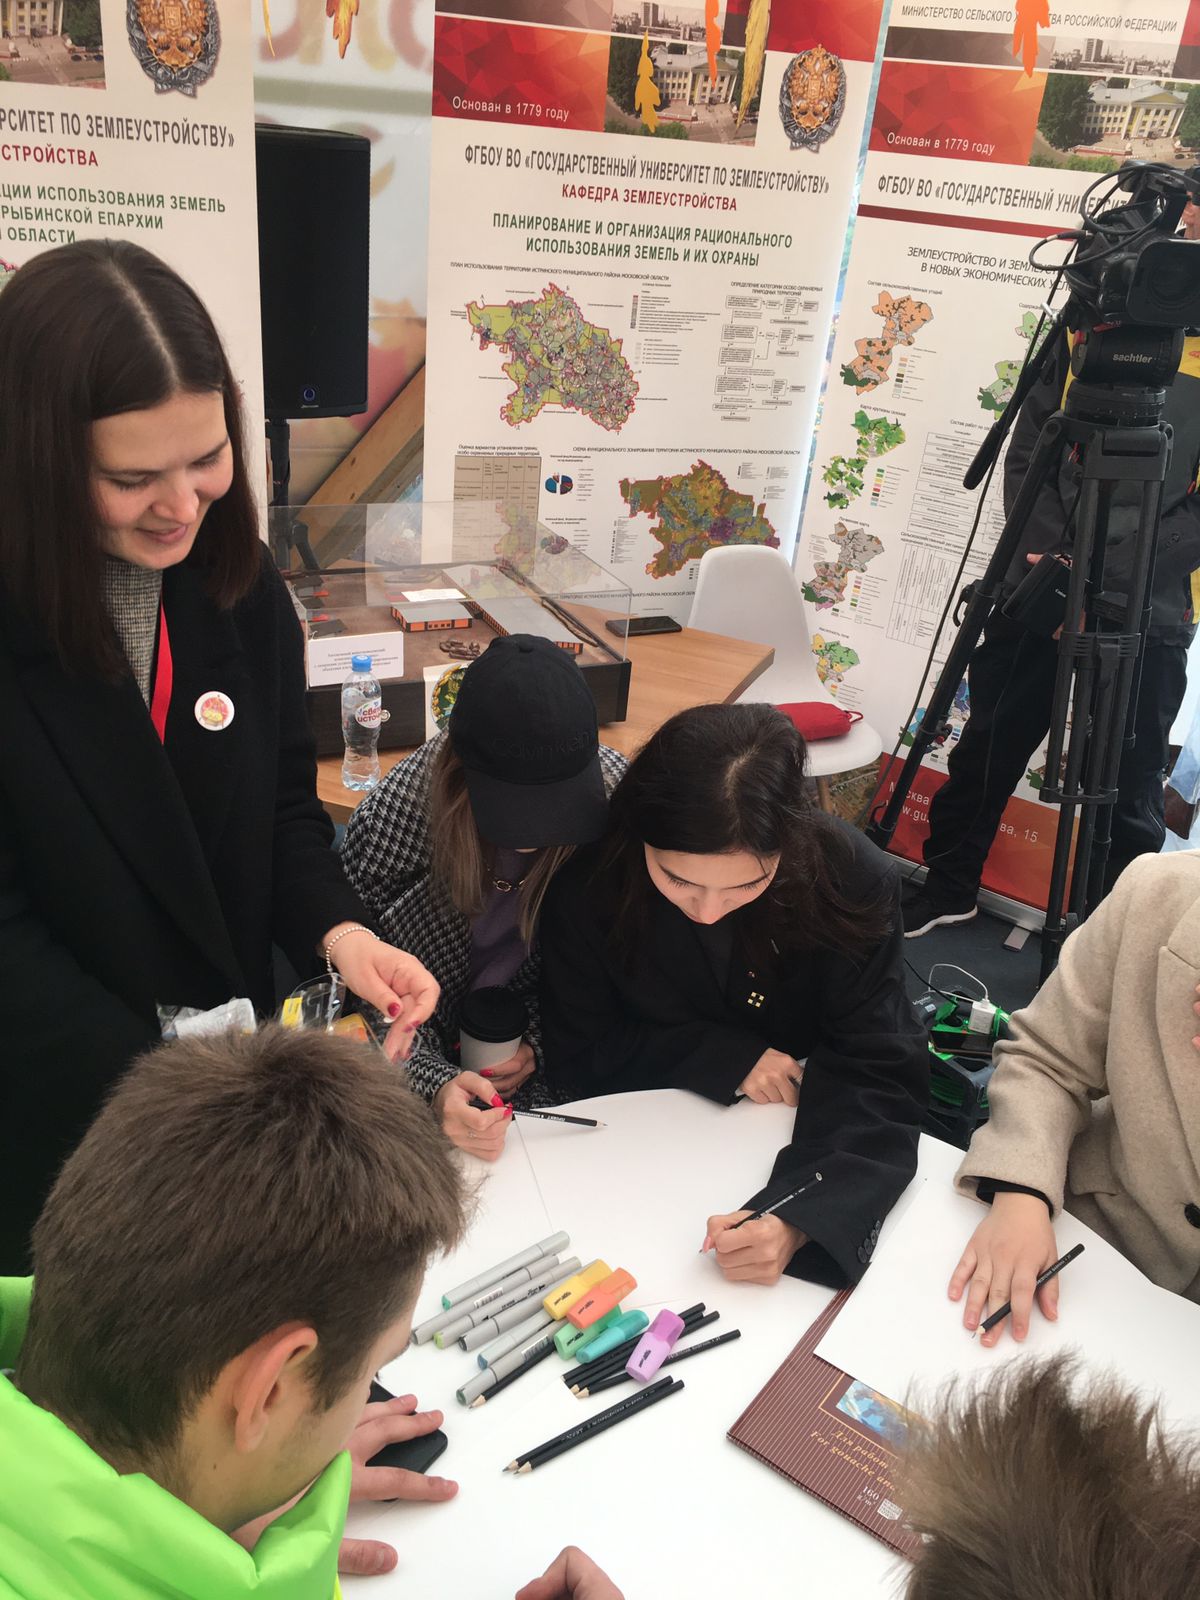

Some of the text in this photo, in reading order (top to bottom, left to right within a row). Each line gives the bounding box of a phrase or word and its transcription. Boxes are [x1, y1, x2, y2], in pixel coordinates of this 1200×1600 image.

[901, 5, 963, 20] МИНИСТЕРСТВО
[965, 8, 1012, 22] СЕЛЬСКОГО
[1064, 13, 1122, 29] РОССИЙСКОЙ
[1124, 18, 1178, 32] ФЕДЕРАЦИИ
[452, 95, 569, 123] Основан в 1779 году
[60, 112, 81, 136] ПО
[86, 114, 235, 148] ЗЕМЛЕУСТРОЙСТВУ»
[887, 132, 995, 156] Основан в 1779 году
[465, 144, 830, 194] ФГБОУ ВО «ГОСУДАРСТВЕННЫЙ УНИВЕРСИТЕТ ПО ЗЕМЛЕУСТРОЙСТВУ»
[0, 183, 226, 213] ЦИИ ИСПОЛЬЗОВАНИЯ ЗЕМЕЛЬ
[562, 183, 738, 211] КАФЕДРА ЗЕМЛЕУСТРОЙСТВА
[878, 174, 914, 197] ФГБОУ
[917, 178, 933, 199] ВО
[935, 180, 1054, 211] «ГОСУДАРСТВЕННЫЙ
[1, 205, 164, 230] РЫБИНСКОЙ ЕПАРХИИ
[493, 213, 793, 249] ПЛАНИРОВАНИЕ И ОРГАНИЗАЦИЯ РАЦИОНАЛЬНОГО
[7, 226, 76, 244] ОБЛАСТИ
[526, 237, 760, 267] ИСПОЛЬЗОВАНИЯ ЗЕМЕЛЬ И ИХ ОХРАНЫ
[907, 246, 997, 268] ЗЕМЛЕУСТРОЙСТВО
[999, 257, 1007, 268] И
[921, 262, 927, 272] В
[929, 264, 960, 279] НОВЫХ
[963, 267, 1047, 290] ЭКОНОМИЧЕСКИХ
[1112, 353, 1153, 364] sachtler
[1024, 829, 1039, 843] 15
[810, 1430, 830, 1447] For
[829, 1446, 876, 1476] gouache
[831, 1430, 889, 1469] Для работ
[862, 1486, 880, 1501] 160
